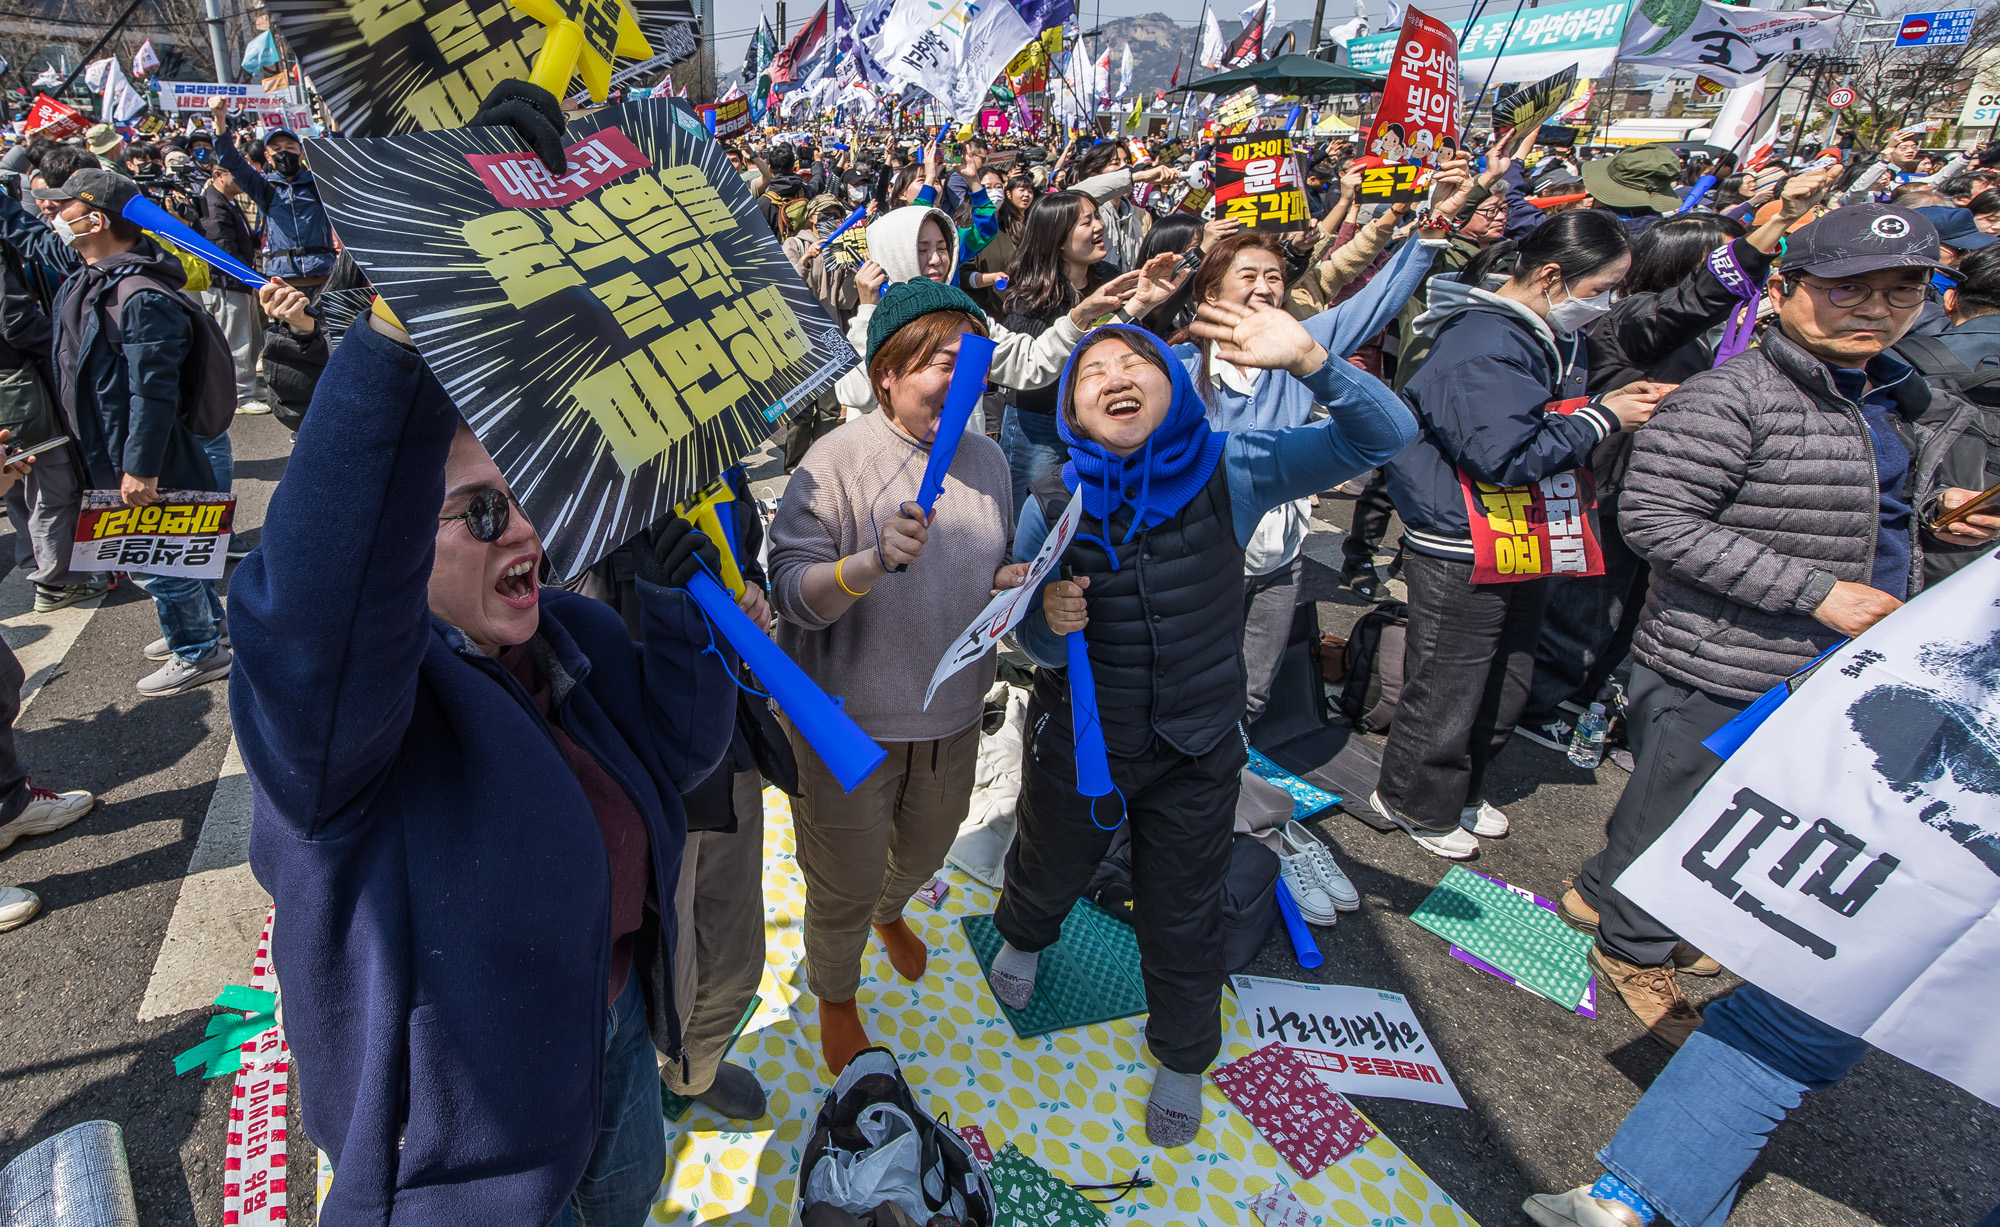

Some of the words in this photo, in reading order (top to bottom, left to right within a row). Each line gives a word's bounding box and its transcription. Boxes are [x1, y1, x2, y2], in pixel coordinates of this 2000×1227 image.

[1521, 4, 1622, 47] 파면하라!
[1400, 40, 1457, 97] 윤석열
[705, 99, 748, 122] 석열을
[1404, 85, 1450, 132] 빛의
[1834, 93, 1849, 104] 30
[714, 116, 749, 140] 면하라!
[1232, 139, 1282, 161] 이것이
[461, 163, 739, 311] 윤석열을
[569, 284, 816, 478] 파면하라
[92, 504, 227, 539] 파면하라
[1474, 481, 1542, 575] 윤석
[1539, 471, 1588, 575] 파면하
[97, 537, 217, 566] 윤석열을
[999, 970, 1019, 982] NEPA
[1255, 1005, 1424, 1053] 해체하라!
[1354, 1057, 1444, 1085] 내란동조
[247, 1079, 270, 1161] DANGER
[1165, 1108, 1189, 1121] NEPA
[243, 1168, 268, 1216] 위험
